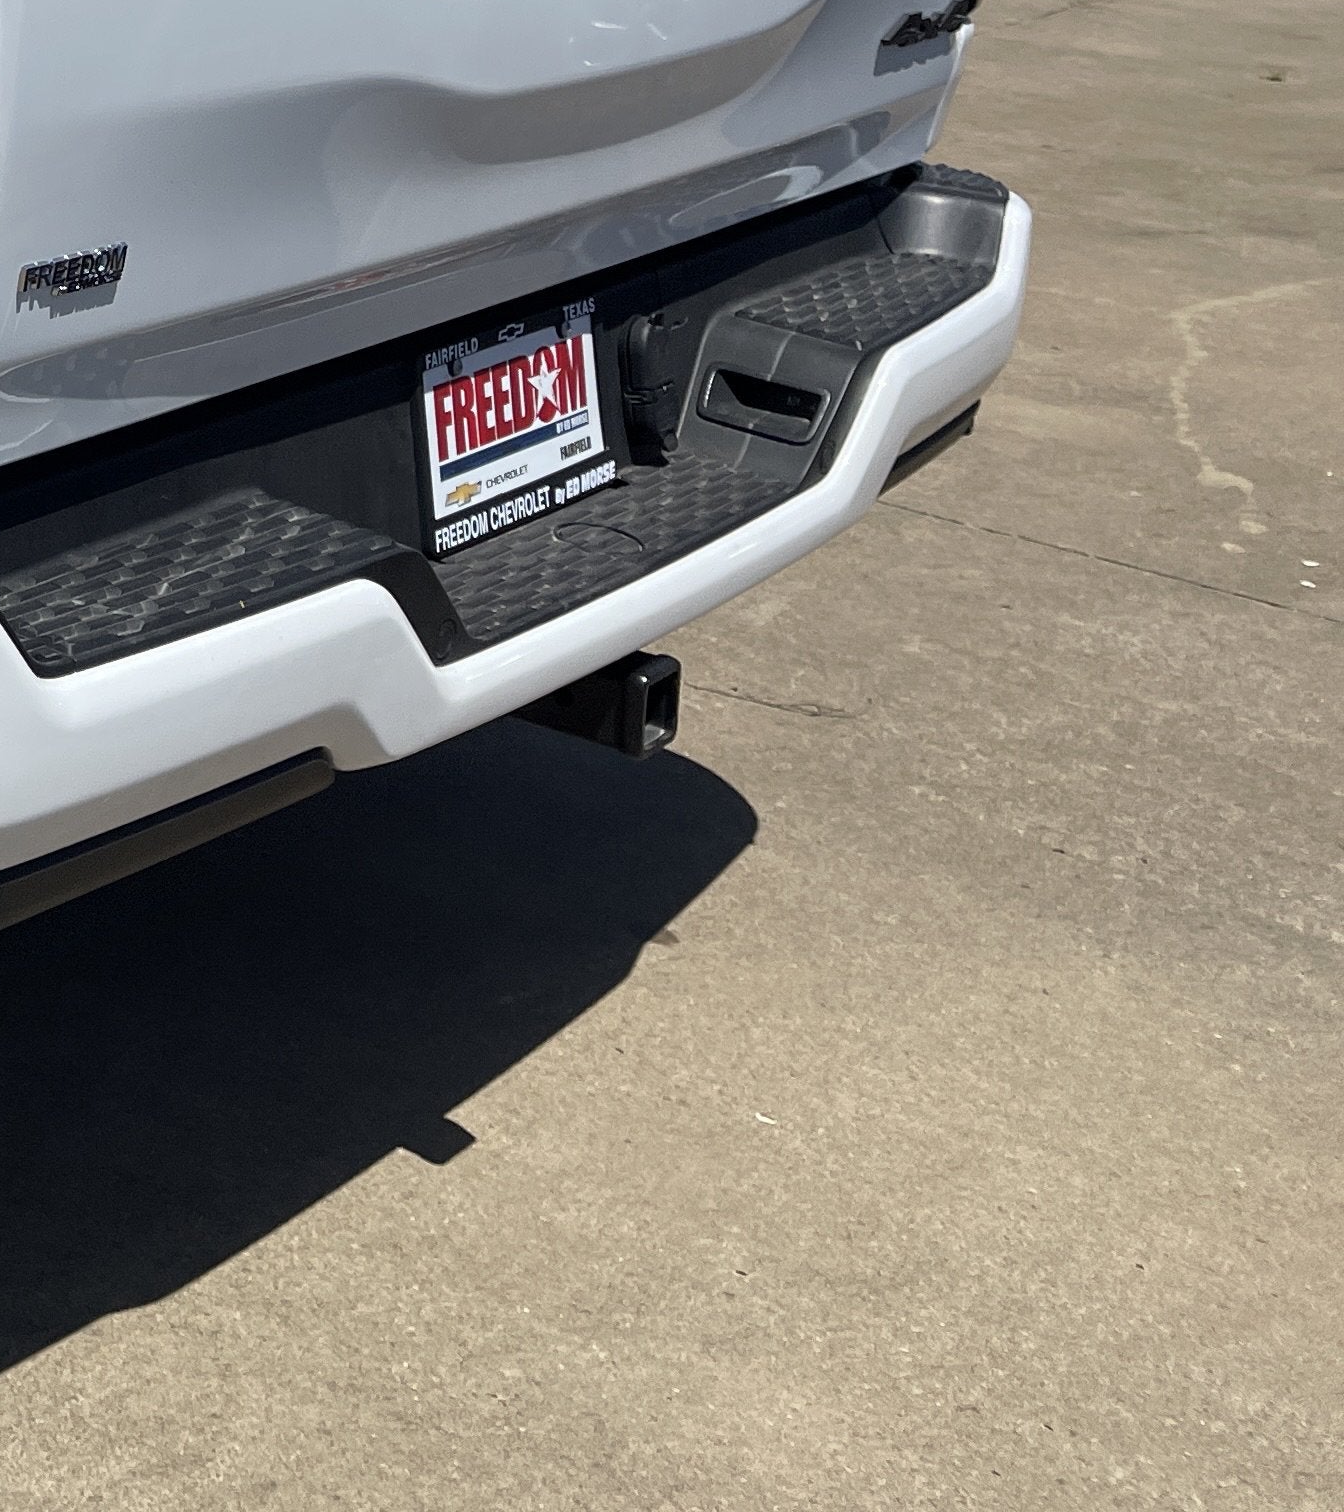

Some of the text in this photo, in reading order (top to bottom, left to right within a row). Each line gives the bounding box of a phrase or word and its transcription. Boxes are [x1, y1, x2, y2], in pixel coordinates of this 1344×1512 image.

[18, 241, 128, 292] FREEDOM
[425, 297, 595, 370] FAIRFIELD TEXAS
[432, 334, 588, 463] FREEDOM
[434, 516, 489, 554] FREEDOM
[490, 485, 551, 529] CHEVROLET
[566, 476, 581, 500] ED
[581, 460, 616, 493] MORSE
[485, 464, 529, 489] CHEVROLET
